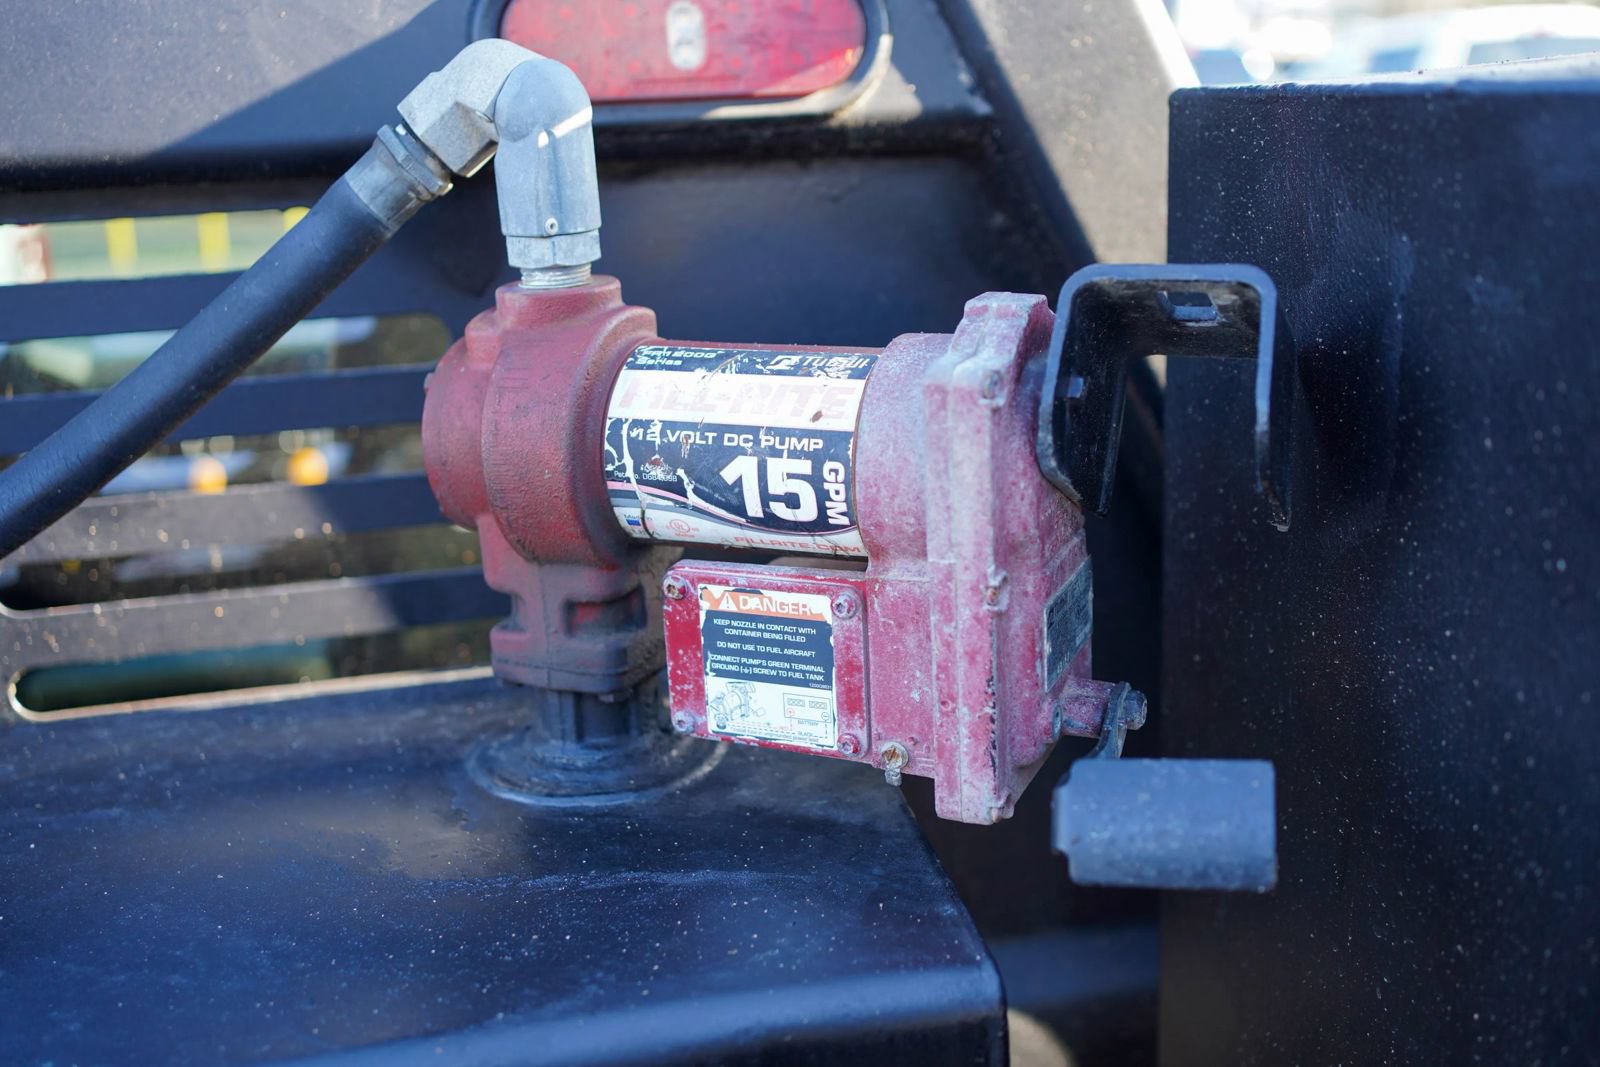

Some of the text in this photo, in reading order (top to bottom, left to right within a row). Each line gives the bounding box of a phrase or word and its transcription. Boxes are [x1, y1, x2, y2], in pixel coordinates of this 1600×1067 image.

[636, 358, 682, 366] Series
[666, 430, 717, 445] VOLT
[724, 432, 753, 447] DC
[761, 437, 824, 452] PUMP
[720, 455, 818, 522] 15
[822, 460, 850, 526] GPM
[734, 536, 861, 553] FILLRITE.COM
[738, 596, 810, 616] DANGER
[724, 628, 806, 642] CONTAINER BEING FILLED
[731, 620, 756, 628] NOZZLE
[766, 624, 796, 632] CONTACT
[797, 626, 816, 635] WITH
[784, 649, 816, 658] AIRCRAFT
[710, 654, 825, 672] CONNECT PUMP'S GREEN TERMINAL
[712, 662, 740, 672] GROUND
[753, 667, 778, 676] SCREW
[788, 672, 804, 680] FUEL
[806, 674, 824, 682] TANK
